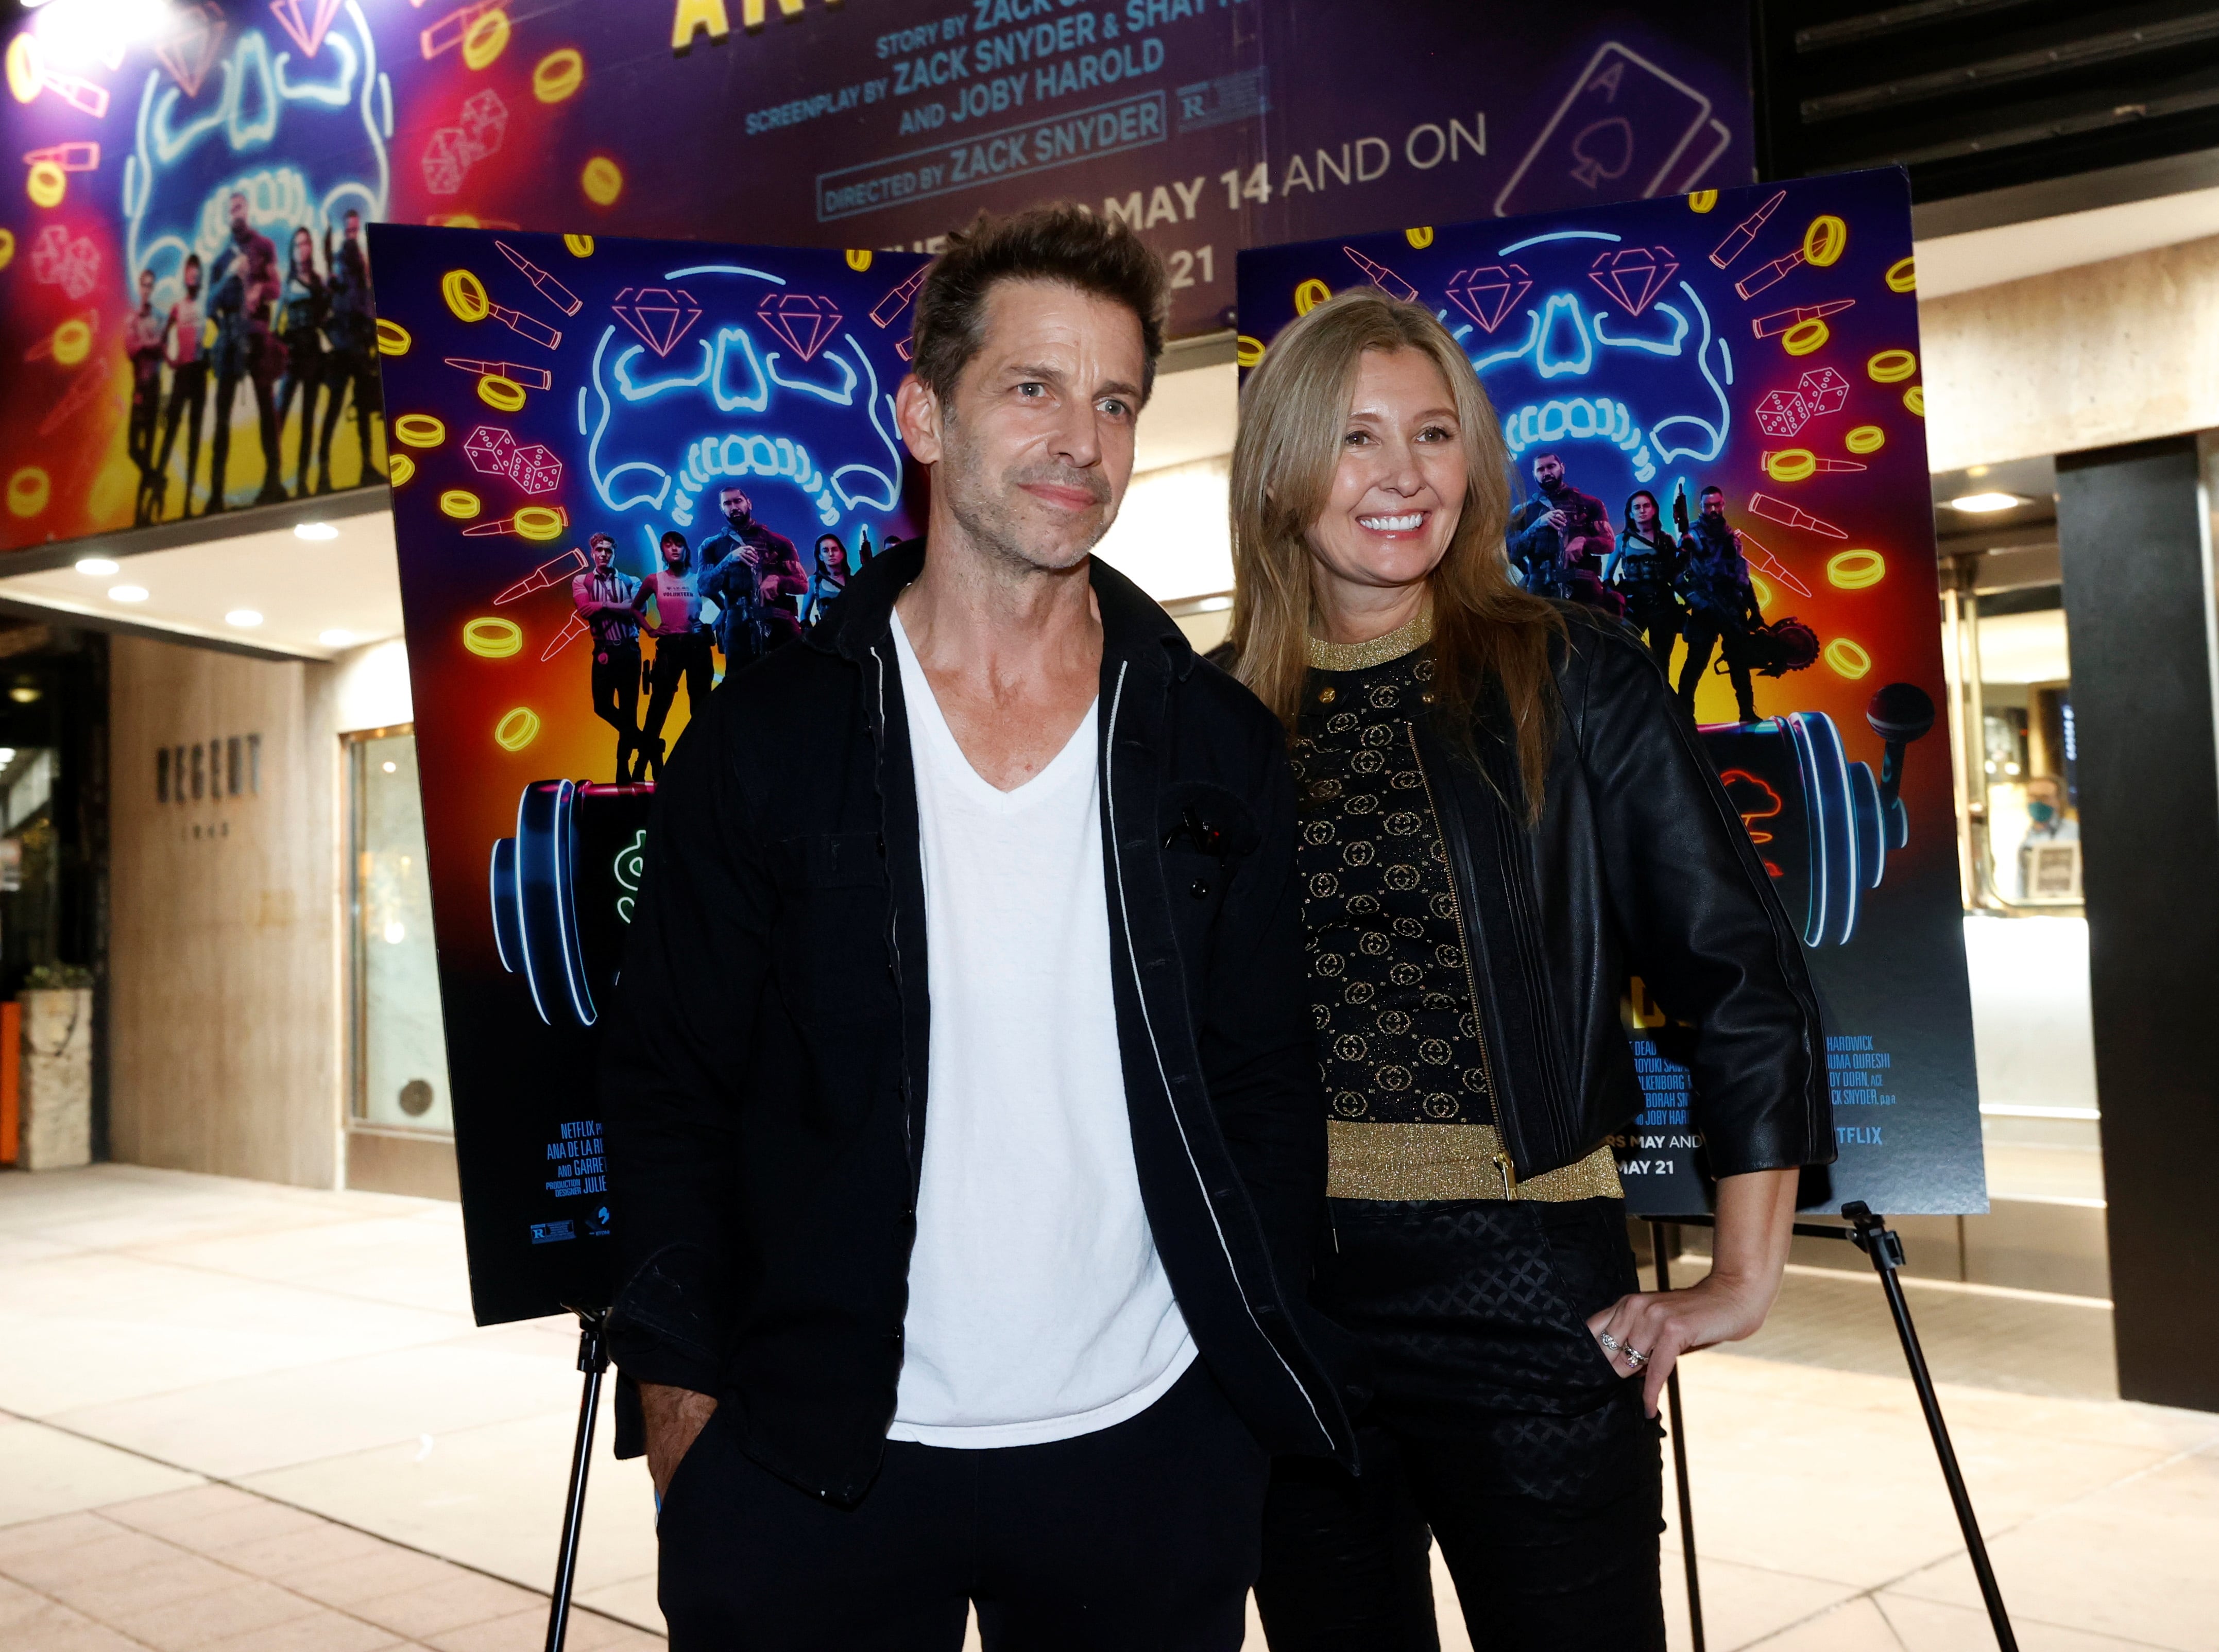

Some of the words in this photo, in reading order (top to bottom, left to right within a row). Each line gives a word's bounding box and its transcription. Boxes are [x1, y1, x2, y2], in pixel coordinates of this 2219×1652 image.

[876, 22, 938, 59] STORY
[942, 13, 968, 40] BY
[745, 84, 860, 135] SCREENPLAY
[863, 77, 888, 104] BY
[893, 45, 969, 96] ZACK
[975, 12, 1096, 73] SNYDER
[1103, 12, 1119, 40] &
[899, 103, 945, 136] AND
[950, 72, 1028, 123] JOBY
[1035, 38, 1165, 101] HAROLD
[825, 171, 917, 212] DIRECTED
[919, 164, 945, 191] BY
[951, 134, 1029, 183] ZACK
[1034, 102, 1160, 162] SNYDER
[1104, 177, 1205, 231] MAY
[1221, 162, 1272, 209] 14
[1282, 136, 1390, 196] AND
[1405, 112, 1487, 169] ON
[1170, 244, 1213, 289] 21
[1827, 1036, 1873, 1051] HARDWICK
[1634, 1058, 1662, 1073] OYUKI
[1853, 1053, 1890, 1069] QURESHI
[1638, 1075, 1684, 1090] LKENBORG
[1644, 1093, 1675, 1108] BORAH
[1645, 1110, 1667, 1125] JOBY
[560, 1121, 595, 1139] NETFLIX
[1837, 1127, 1883, 1145] TFLIX
[1630, 1135, 1665, 1148] MAY
[1669, 1135, 1703, 1148] AND
[547, 1142, 567, 1160] ANA
[568, 1140, 580, 1158] DE
[581, 1139, 593, 1156] LA
[558, 1164, 572, 1178] AND
[1655, 1160, 1674, 1174] 21
[546, 1179, 581, 1191] PRODUCTION
[555, 1187, 582, 1197] DESIGNER
[583, 1175, 607, 1194] JULIE
[533, 1229, 545, 1239] R
